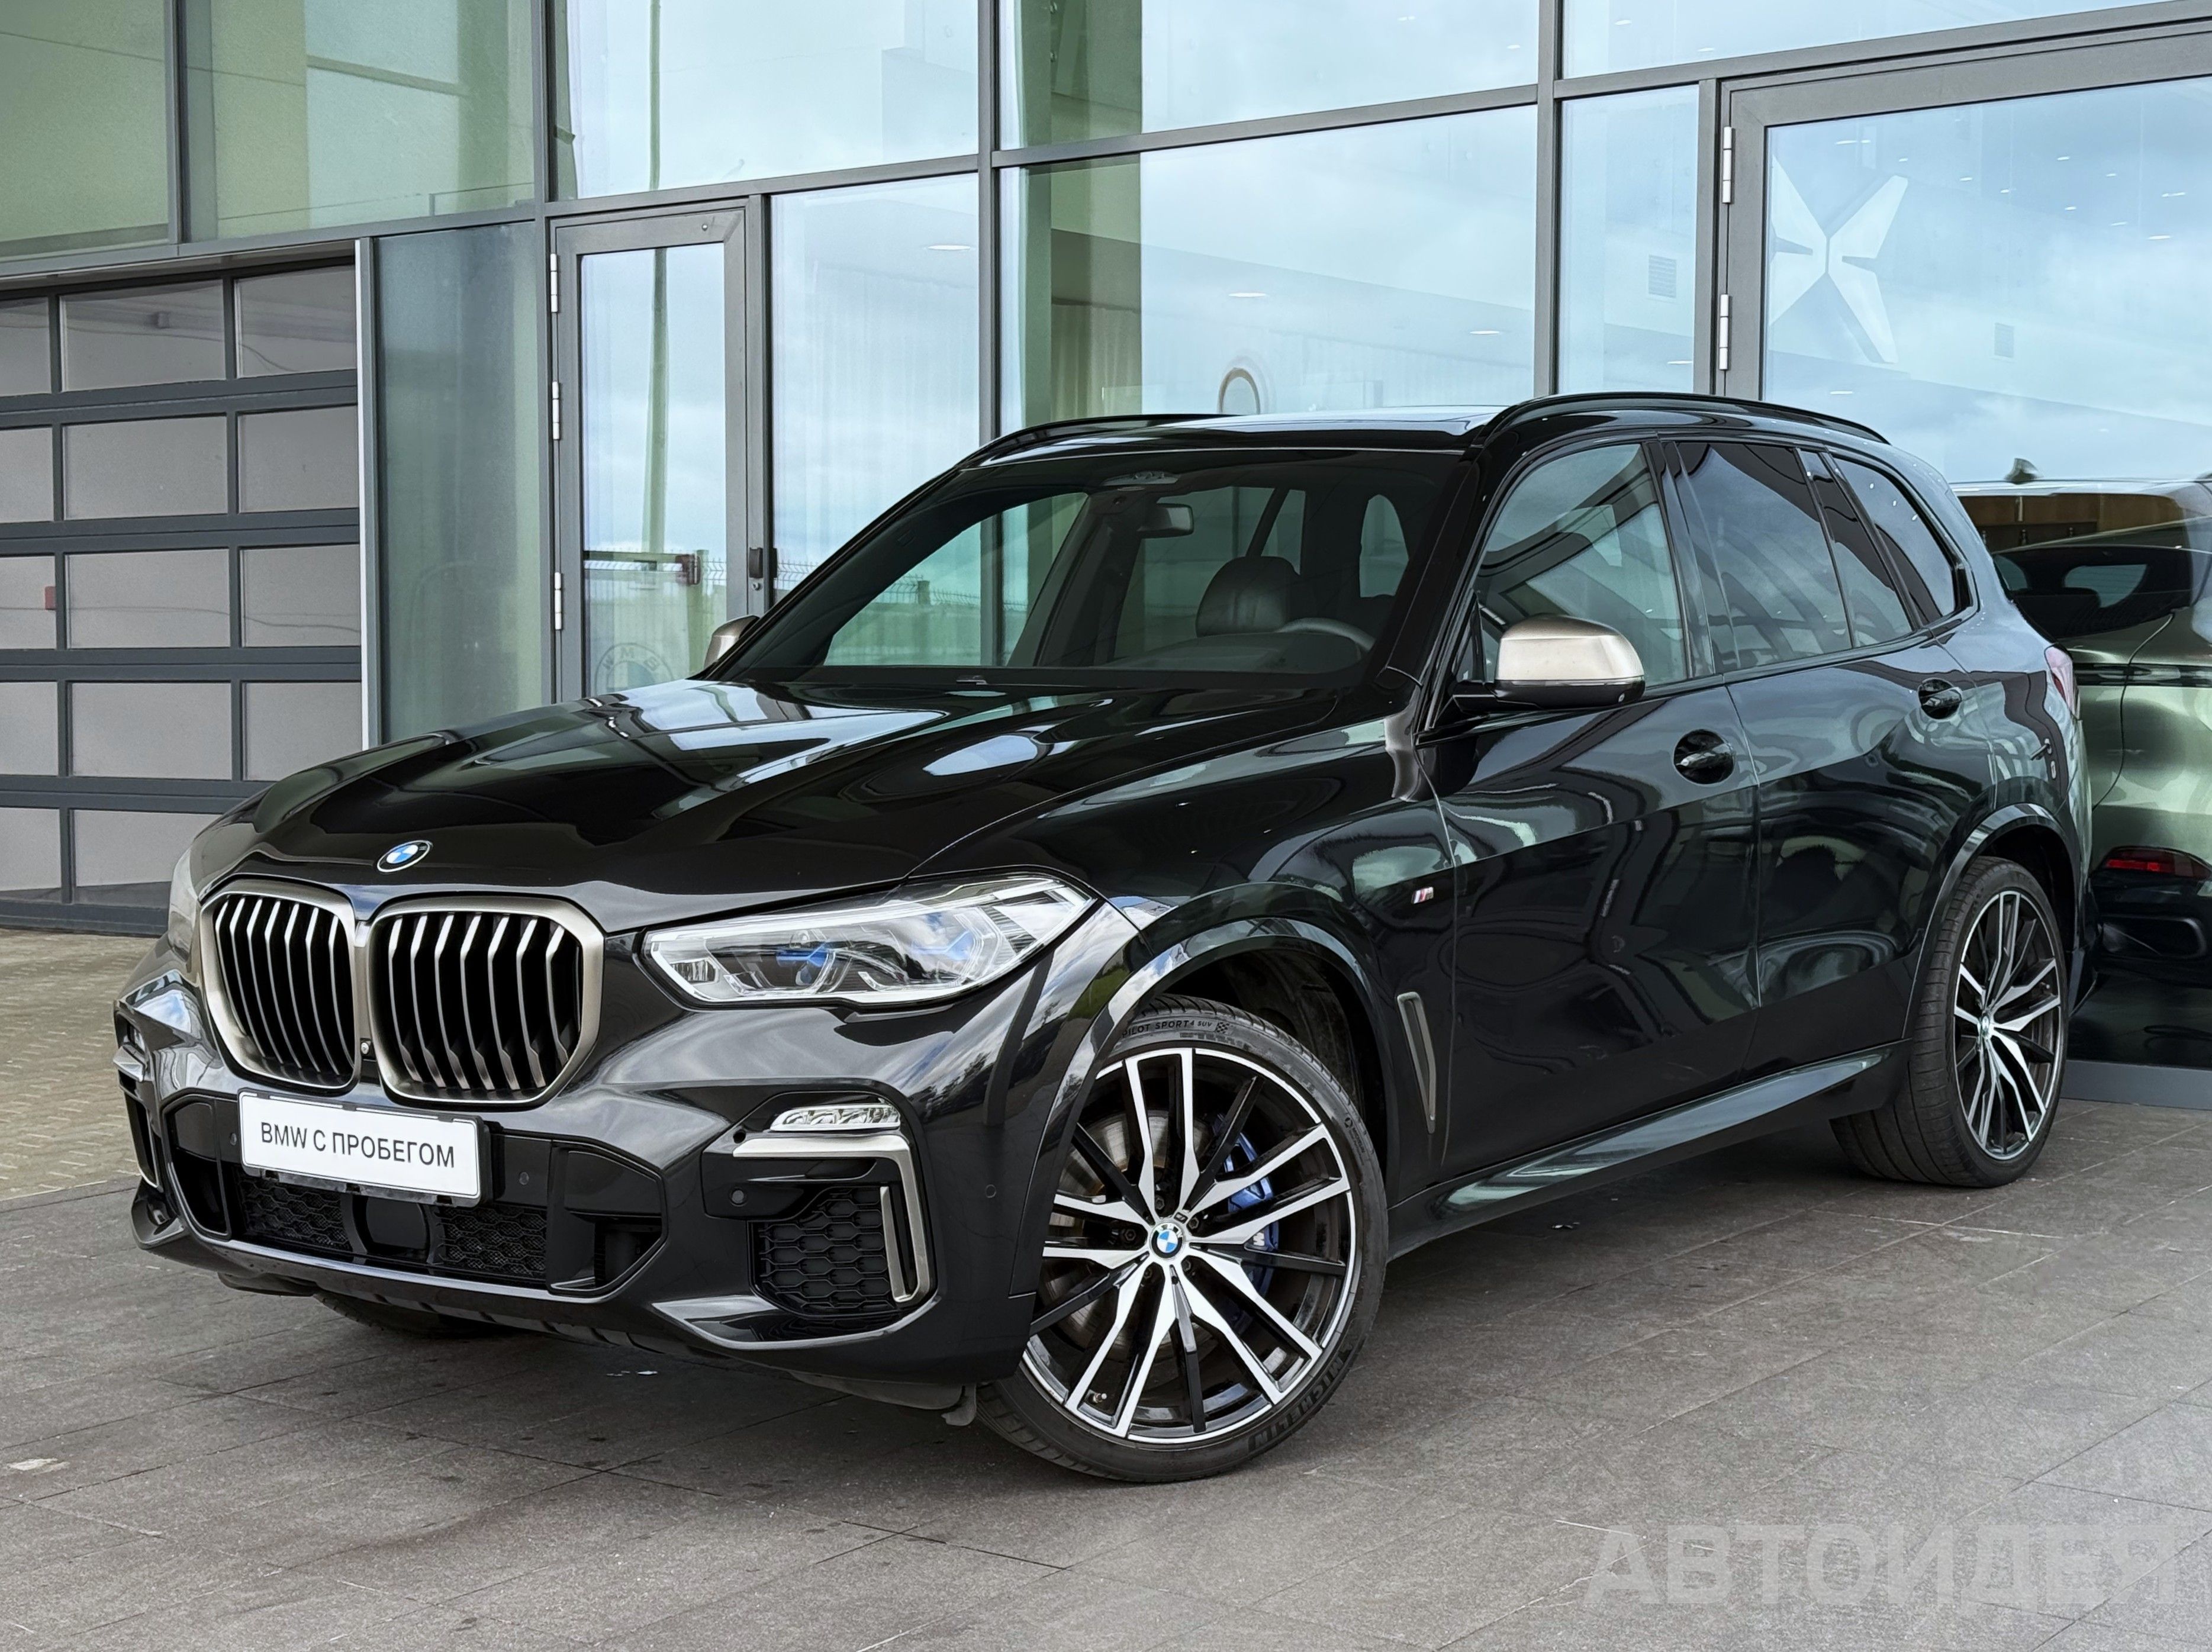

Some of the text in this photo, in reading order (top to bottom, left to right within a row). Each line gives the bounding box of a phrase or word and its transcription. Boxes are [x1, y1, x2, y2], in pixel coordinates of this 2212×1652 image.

[1155, 1020, 1189, 1029] SPORT
[261, 1122, 455, 1168] BMW С ПРОБЕГОМ
[1251, 1355, 1345, 1448] MICHELIN
